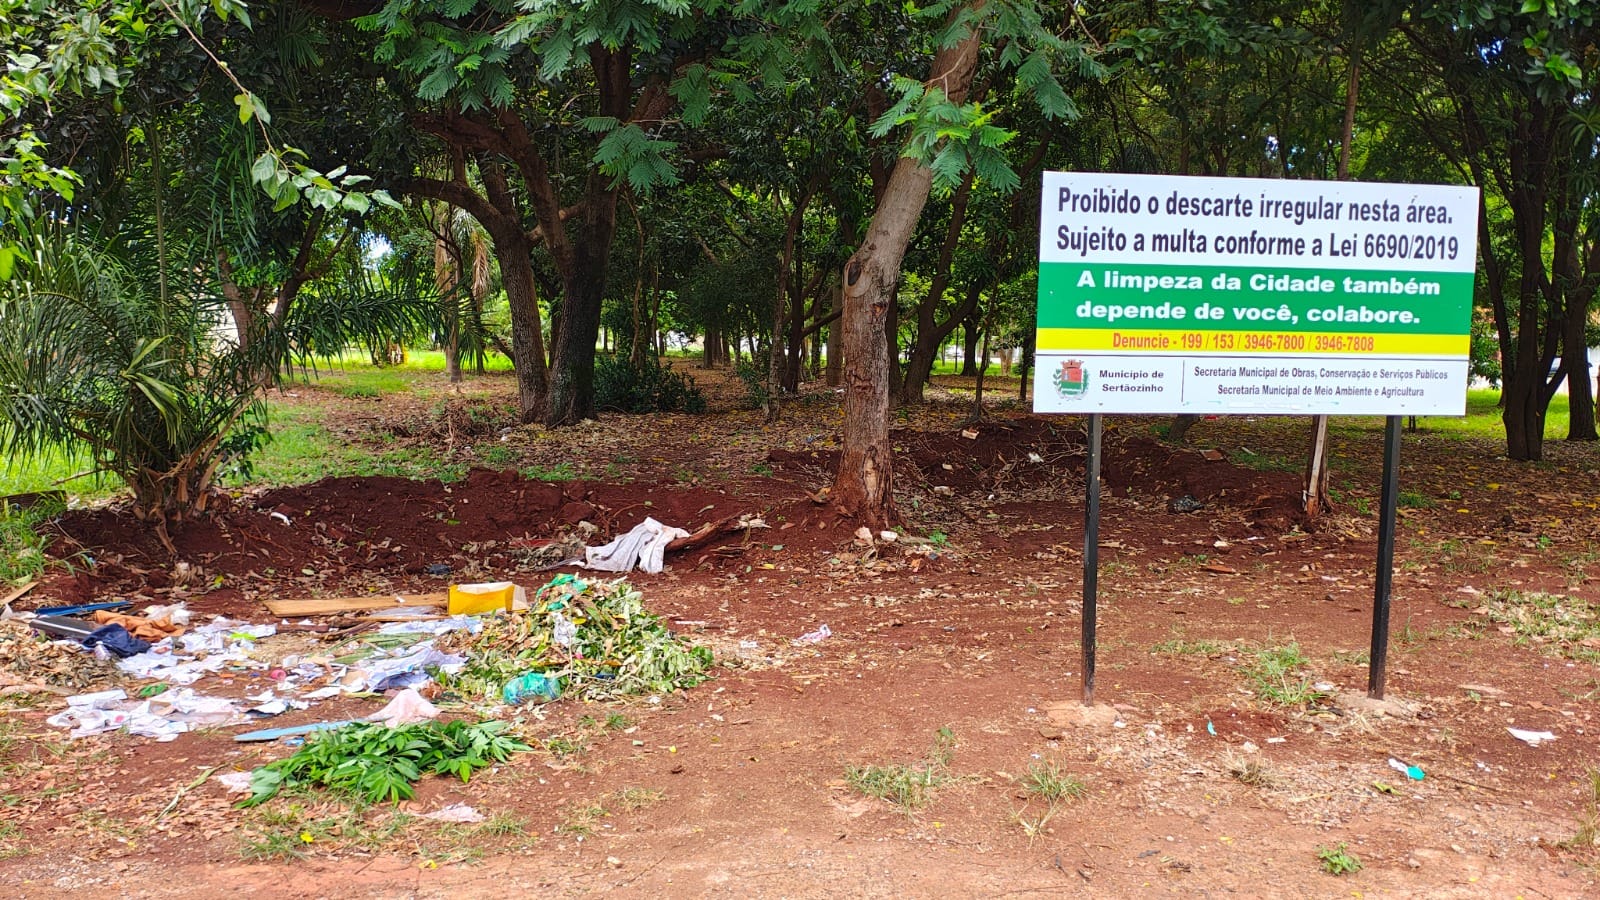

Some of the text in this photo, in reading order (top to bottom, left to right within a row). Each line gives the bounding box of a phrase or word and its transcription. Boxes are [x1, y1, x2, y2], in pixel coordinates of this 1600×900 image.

[1058, 187, 1453, 225] Proibido o descarte irregular nesta área.
[1057, 224, 1459, 260] Sujeito a multa conforme a Lei 6690/2019
[1076, 270, 1440, 295] A limpeza da Cidade também
[1076, 300, 1420, 325] depende de você, colabore.
[1112, 332, 1169, 348] Denuncie
[1181, 333, 1202, 349] 199
[1212, 334, 1234, 349] 153
[1244, 335, 1305, 351] 3946-7800
[1315, 336, 1375, 351] 3946-7808
[1151, 370, 1164, 378] de
[1194, 366, 1237, 377] Secretaria
[1239, 367, 1277, 379] Municipal
[1280, 368, 1289, 377] de
[1291, 367, 1318, 379] Obras,
[1320, 368, 1370, 380] Conservação
[1379, 369, 1413, 381] Serviços
[1102, 383, 1164, 392] Sertãozinho
[1218, 384, 1260, 395] Secretaria
[1262, 385, 1300, 397] Municipal
[1302, 386, 1312, 395] de
[1315, 386, 1333, 396] Meio
[1335, 386, 1372, 396] Ambiente
[1381, 387, 1424, 398] Agricultura
